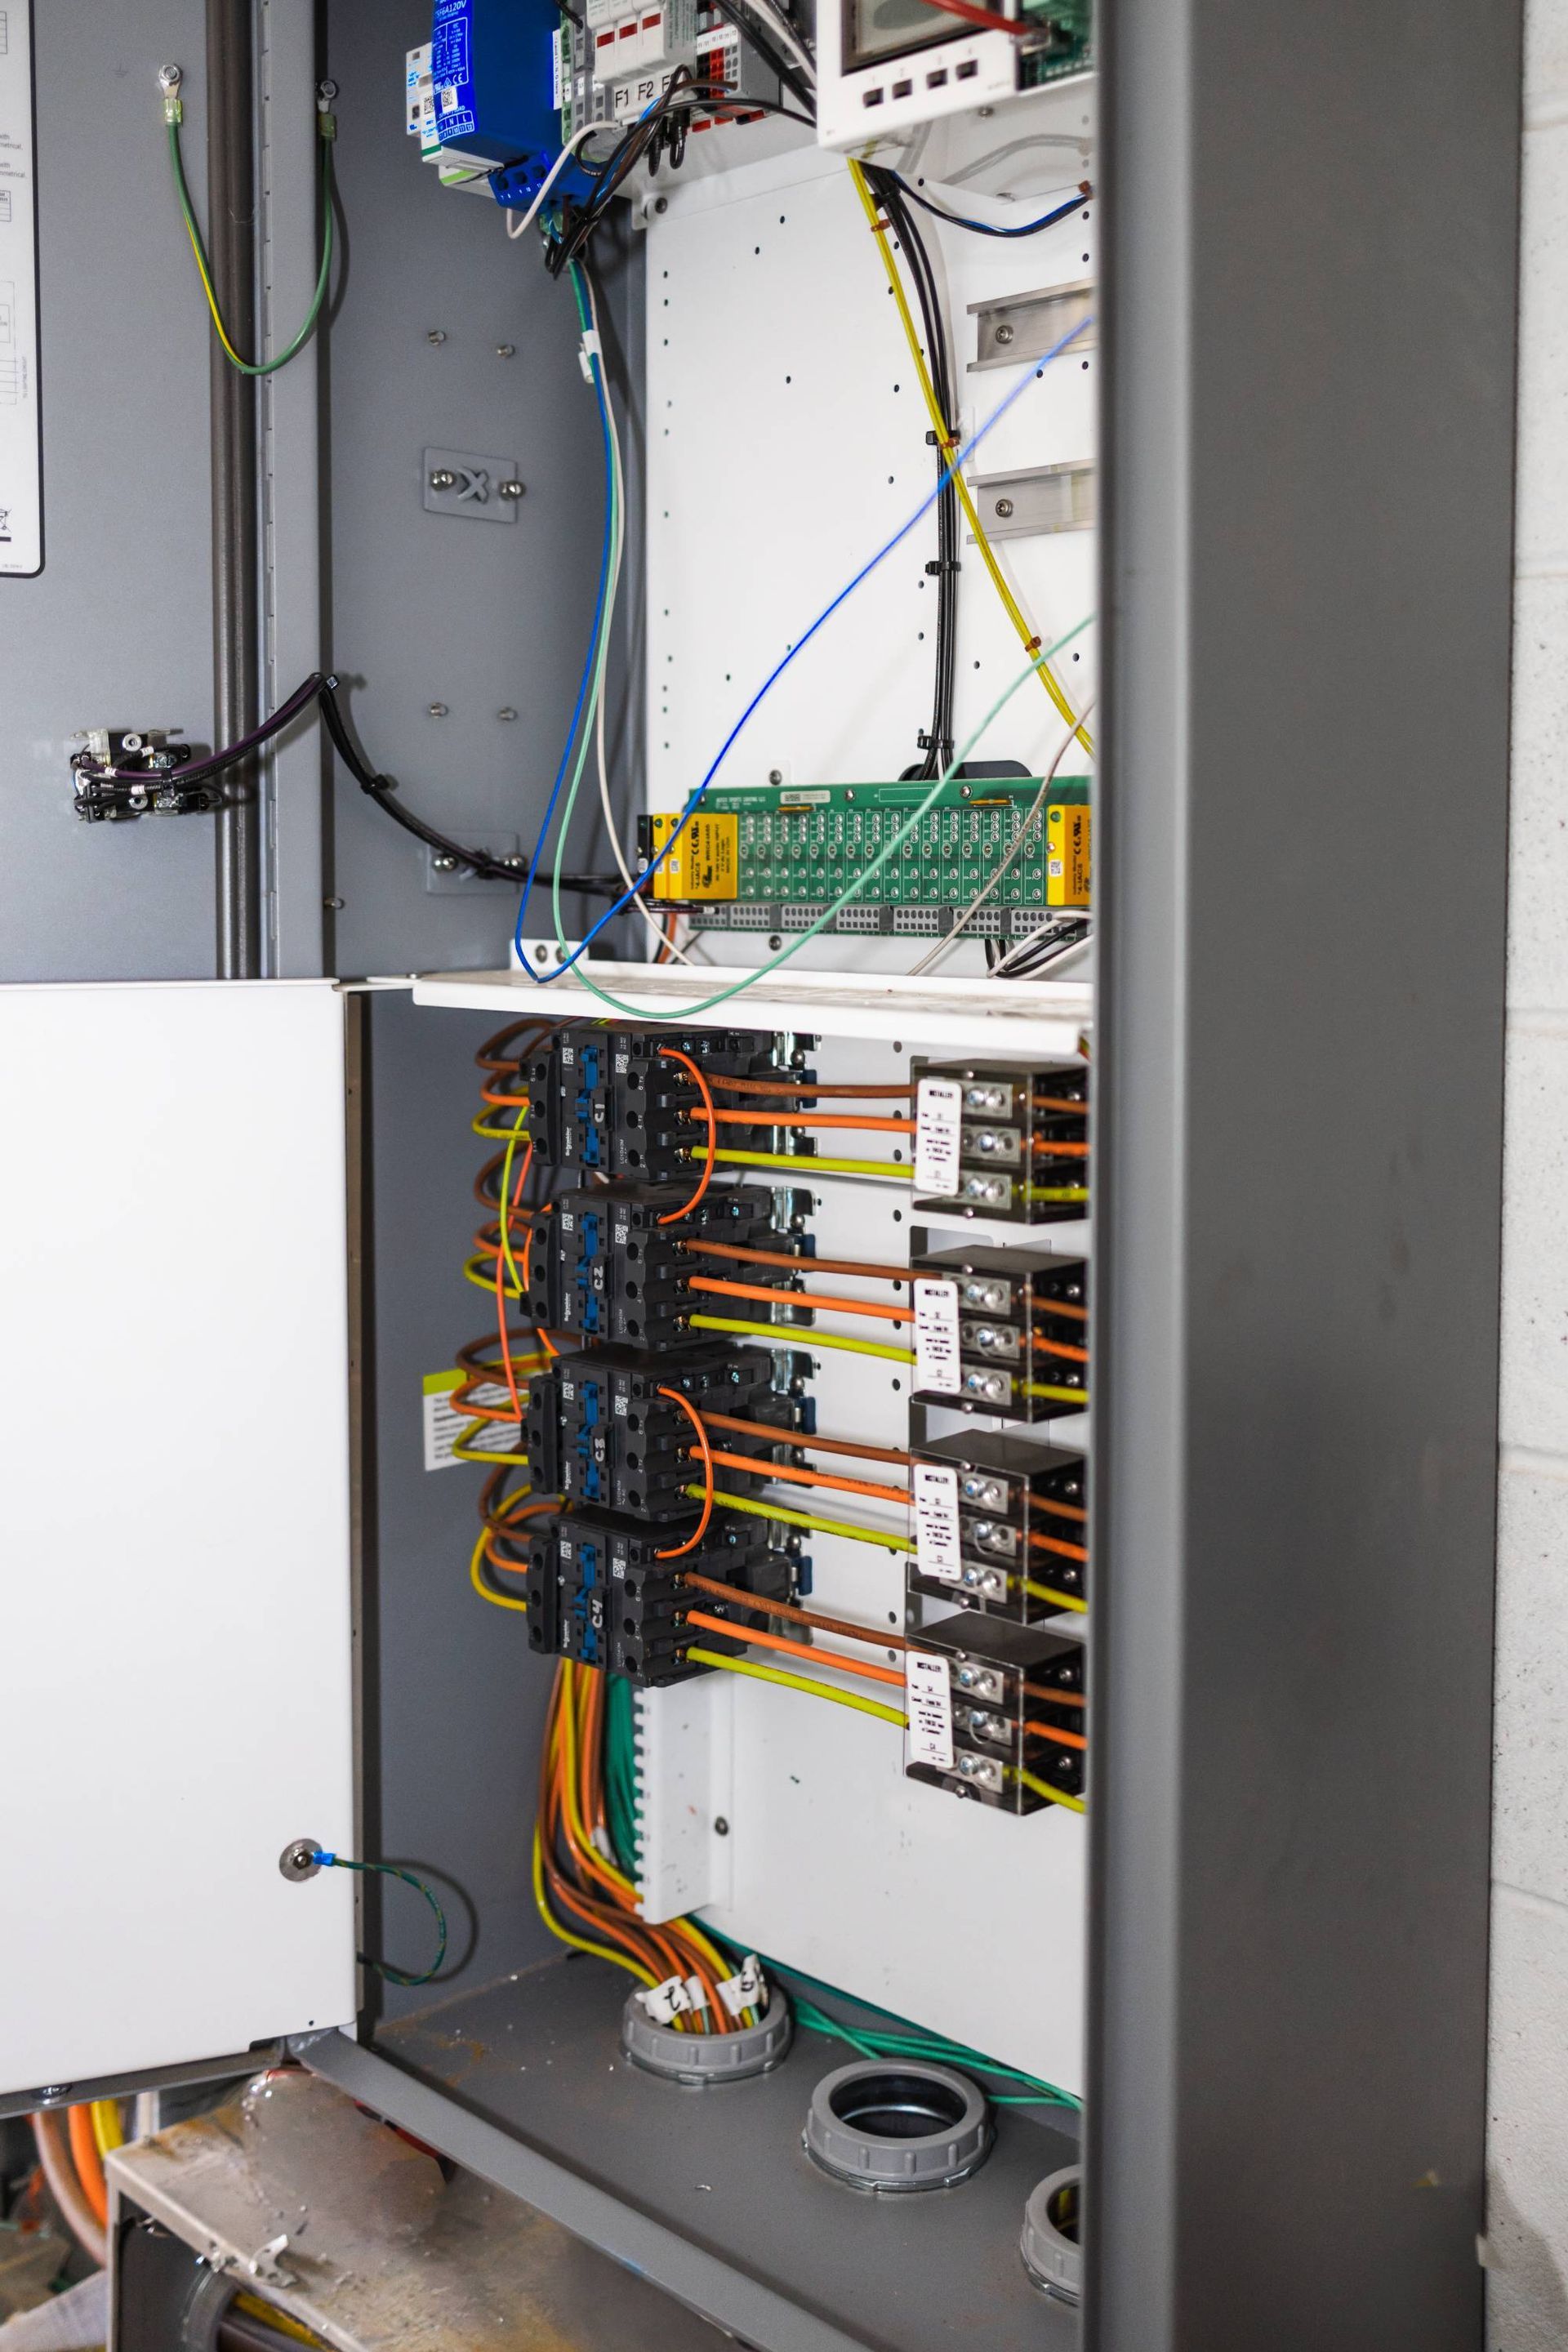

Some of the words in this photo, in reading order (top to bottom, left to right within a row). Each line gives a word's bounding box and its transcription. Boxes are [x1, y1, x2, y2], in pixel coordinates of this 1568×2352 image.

[615, 88, 629, 108] F1
[638, 80, 654, 100] F2
[594, 1266, 604, 1290] C2
[595, 1437, 605, 1463] C3
[592, 1599, 603, 1628] C4
